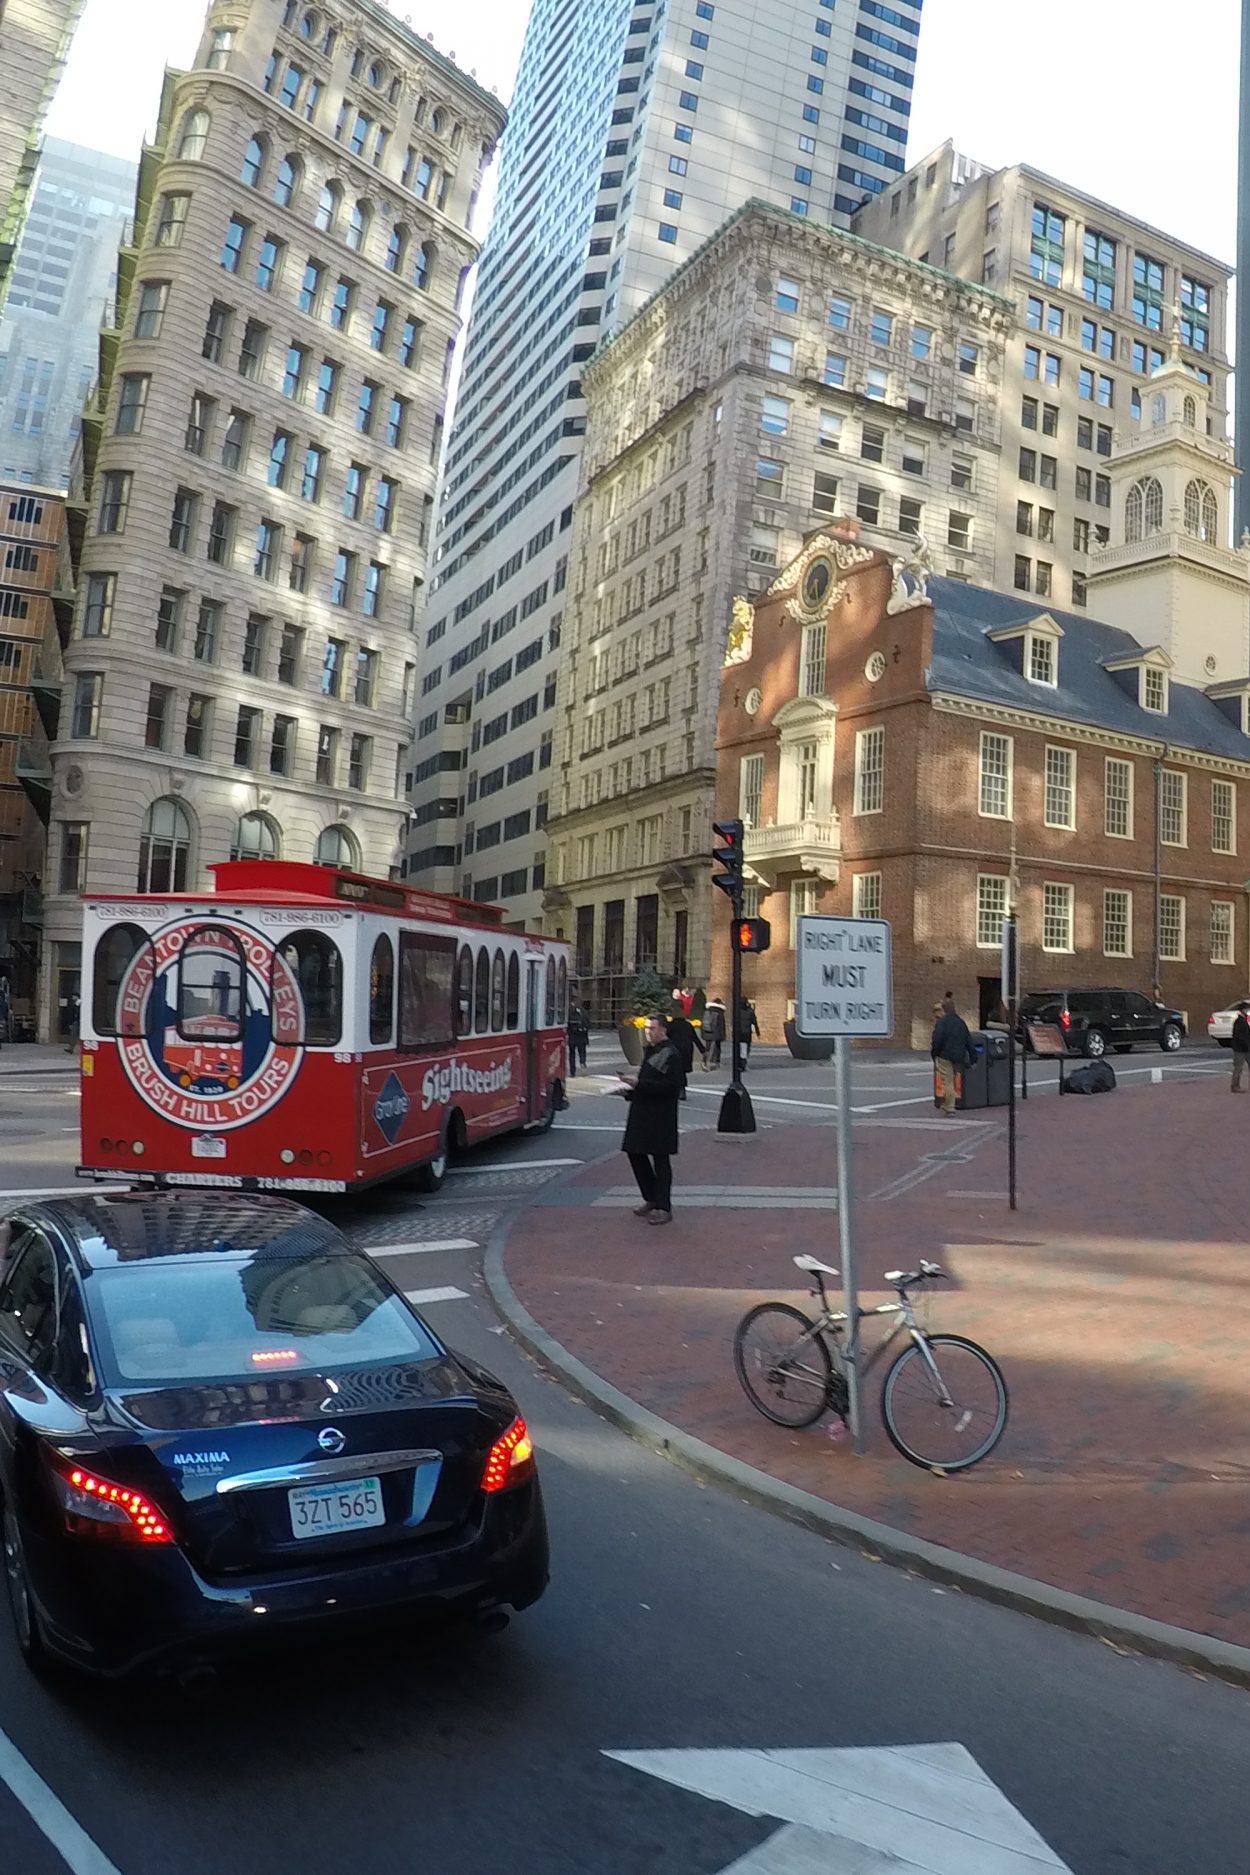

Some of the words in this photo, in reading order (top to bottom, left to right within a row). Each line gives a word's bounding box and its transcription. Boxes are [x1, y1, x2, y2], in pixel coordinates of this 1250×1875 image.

[804, 931, 843, 951] RIGHT
[848, 934, 884, 953] LANE
[821, 963, 867, 988] MUST
[804, 1000, 842, 1020] TURN
[845, 1002, 885, 1021] RIGHT
[126, 1042, 178, 1111] BRUSH
[180, 1099, 229, 1122] HILL
[228, 1057, 289, 1117] TOURS
[421, 1054, 513, 1111] Sightseeing
[166, 1172, 243, 1188] CHARTERS
[173, 1451, 231, 1465] MAXIMA
[295, 1497, 333, 1526] 3ZT
[338, 1491, 378, 1520] 565
